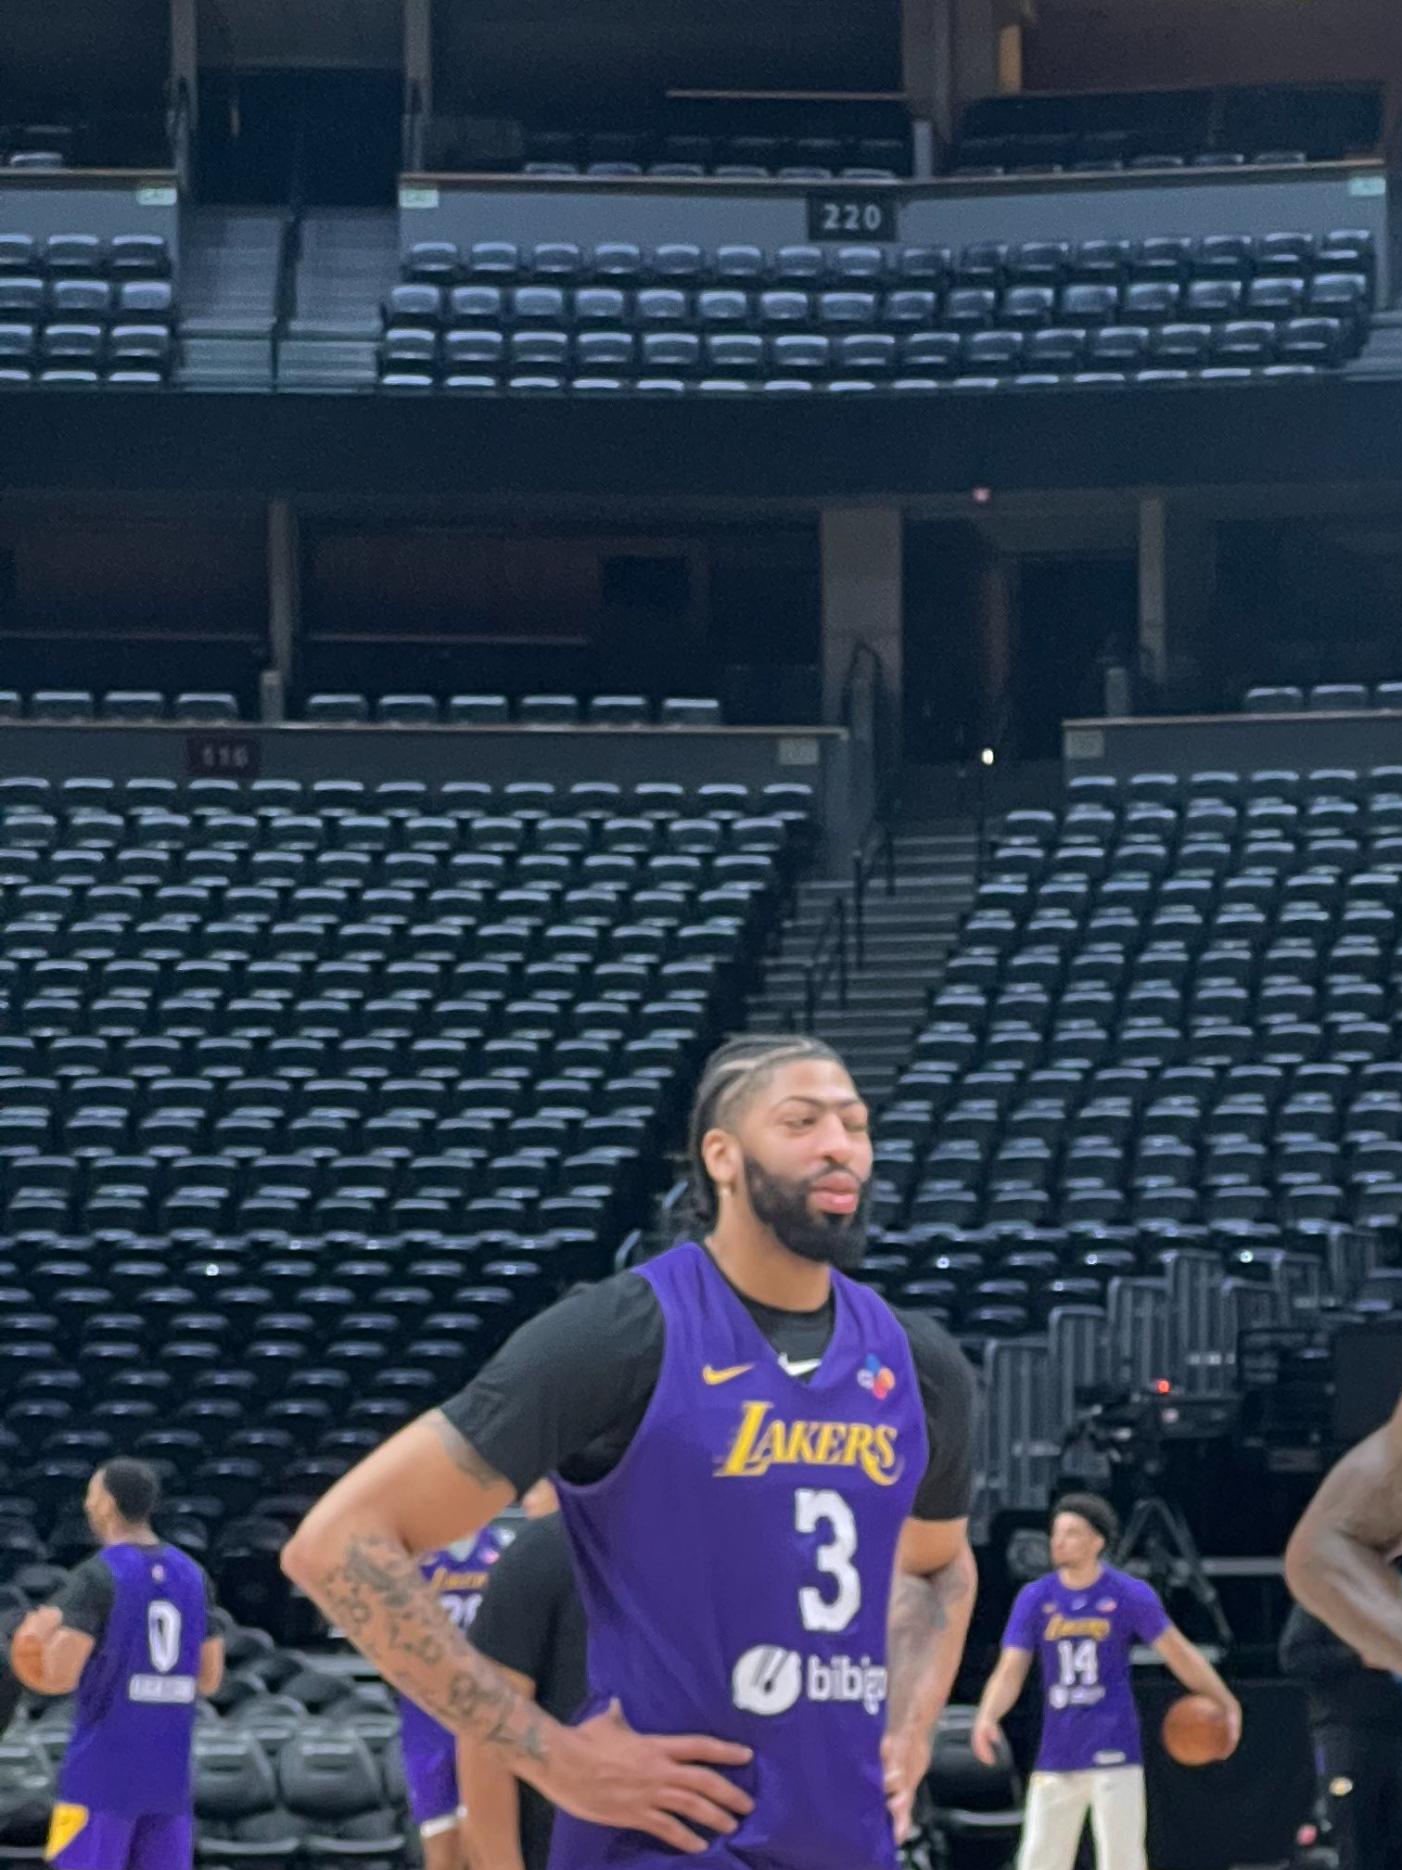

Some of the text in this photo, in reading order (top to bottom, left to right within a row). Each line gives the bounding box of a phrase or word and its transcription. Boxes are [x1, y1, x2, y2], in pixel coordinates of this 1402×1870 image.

[823, 203, 881, 231] 220
[713, 1401, 906, 1486] LAKERS
[795, 1489, 861, 1632] 3
[148, 1600, 182, 1673] 0
[1057, 1639, 1098, 1686] 14
